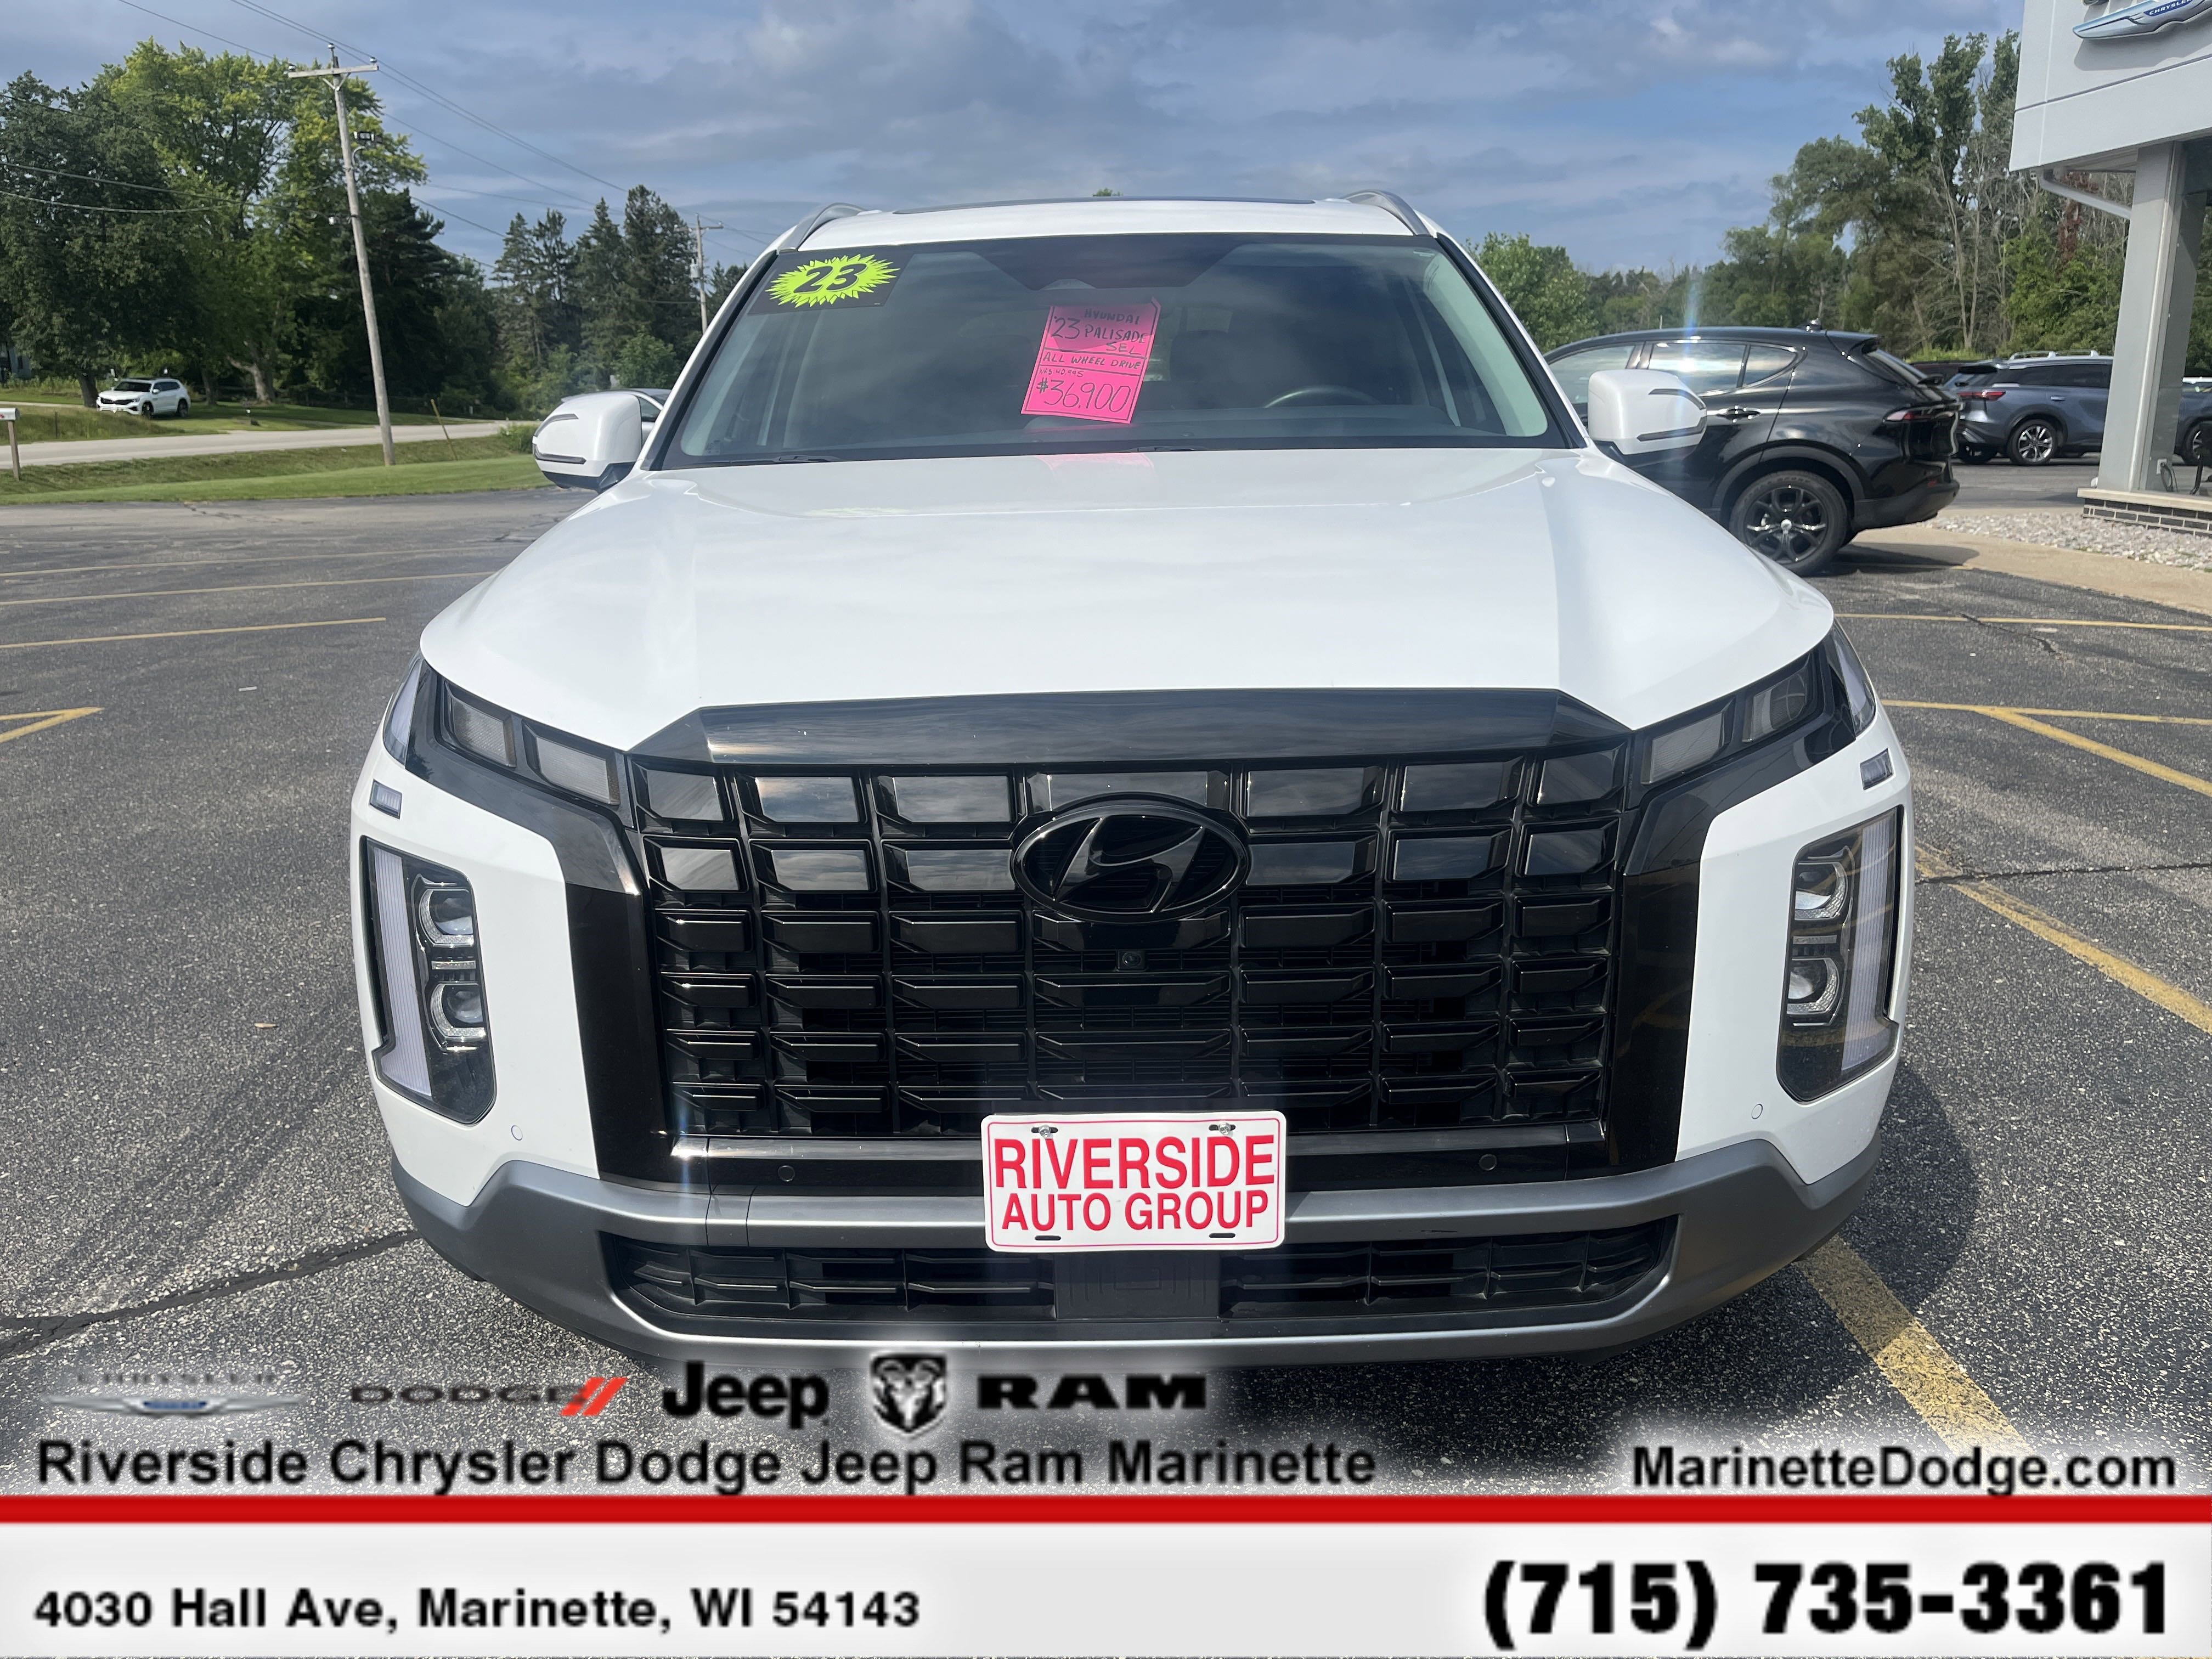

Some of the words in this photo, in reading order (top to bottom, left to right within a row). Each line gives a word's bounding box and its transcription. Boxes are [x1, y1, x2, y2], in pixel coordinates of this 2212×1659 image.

[793, 263, 868, 294] 23
[1084, 308, 1141, 325] HYUNDAI
[1085, 324, 1148, 343] PALISADE
[1106, 341, 1142, 355] SEL
[1043, 352, 1064, 363] ALL
[1071, 357, 1105, 366] WHEEL
[1111, 359, 1142, 370] DRIVE
[994, 1135, 1274, 1189] RIVERSIDE
[1002, 1192, 1111, 1231] AUTO
[1125, 1190, 1268, 1230] GROUP
